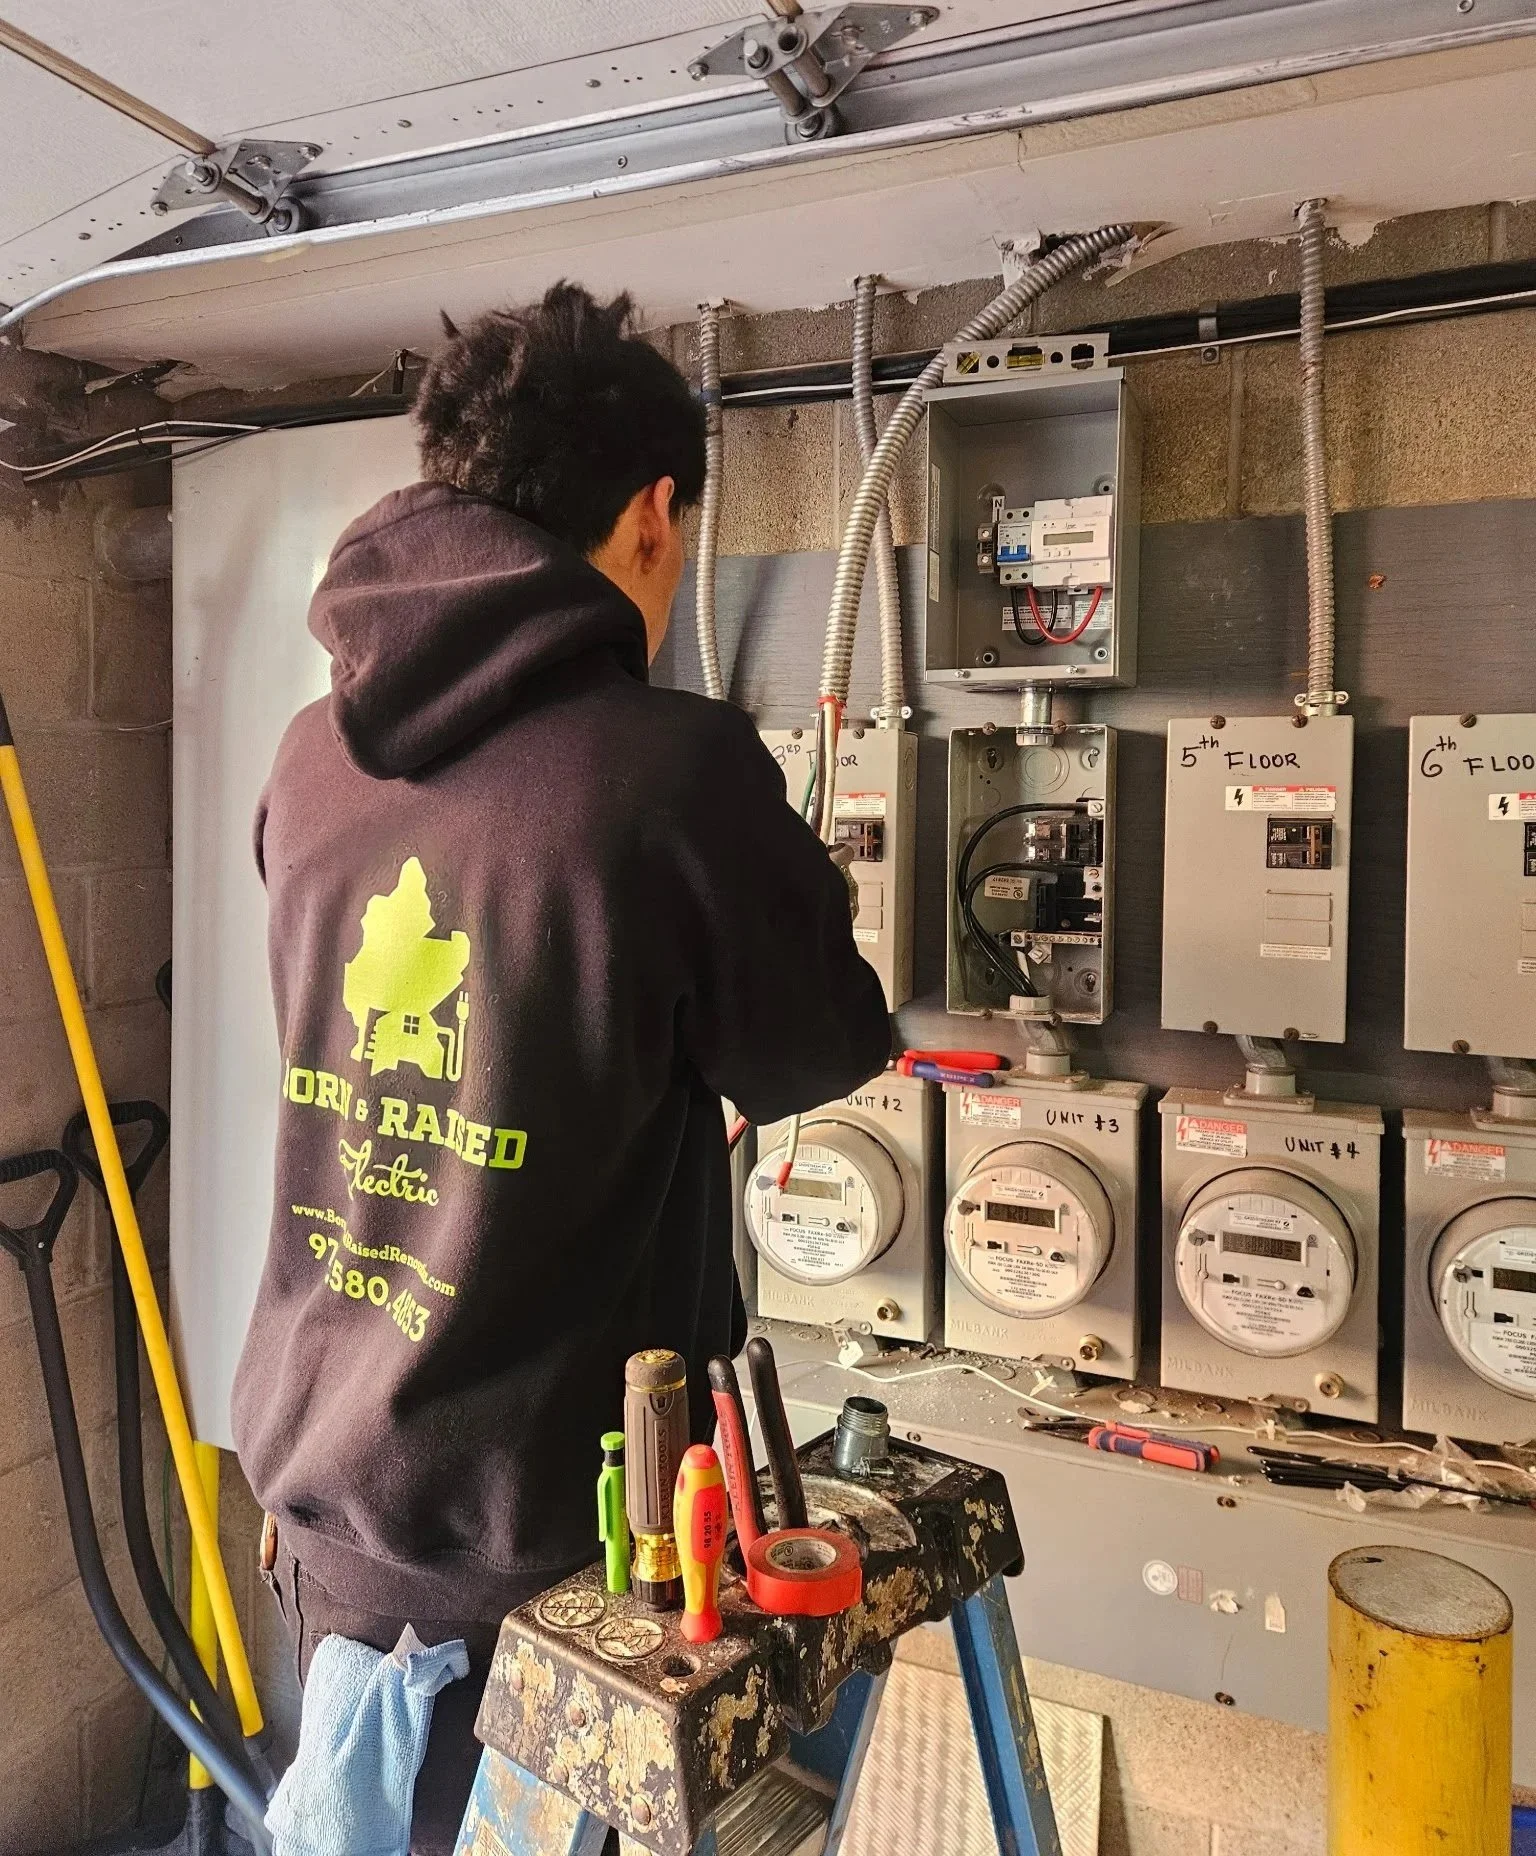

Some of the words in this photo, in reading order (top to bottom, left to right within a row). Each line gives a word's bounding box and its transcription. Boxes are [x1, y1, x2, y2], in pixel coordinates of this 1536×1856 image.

[806, 749, 858, 770] FOR
[1224, 751, 1301, 769] FLOOR
[1463, 754, 1536, 776] FLOO
[980, 1094, 1020, 1107] DANGER
[283, 1058, 353, 1121] ORN
[355, 1098, 369, 1122] &
[377, 1096, 528, 1170] RAISED
[1046, 1109, 1084, 1126] UNIT
[1199, 1119, 1244, 1134] DANGER
[1285, 1137, 1324, 1152] UNIT
[1452, 1142, 1504, 1156] DANGER
[1503, 1330, 1527, 1339] FOCUS
[703, 1525, 712, 1536] 20
